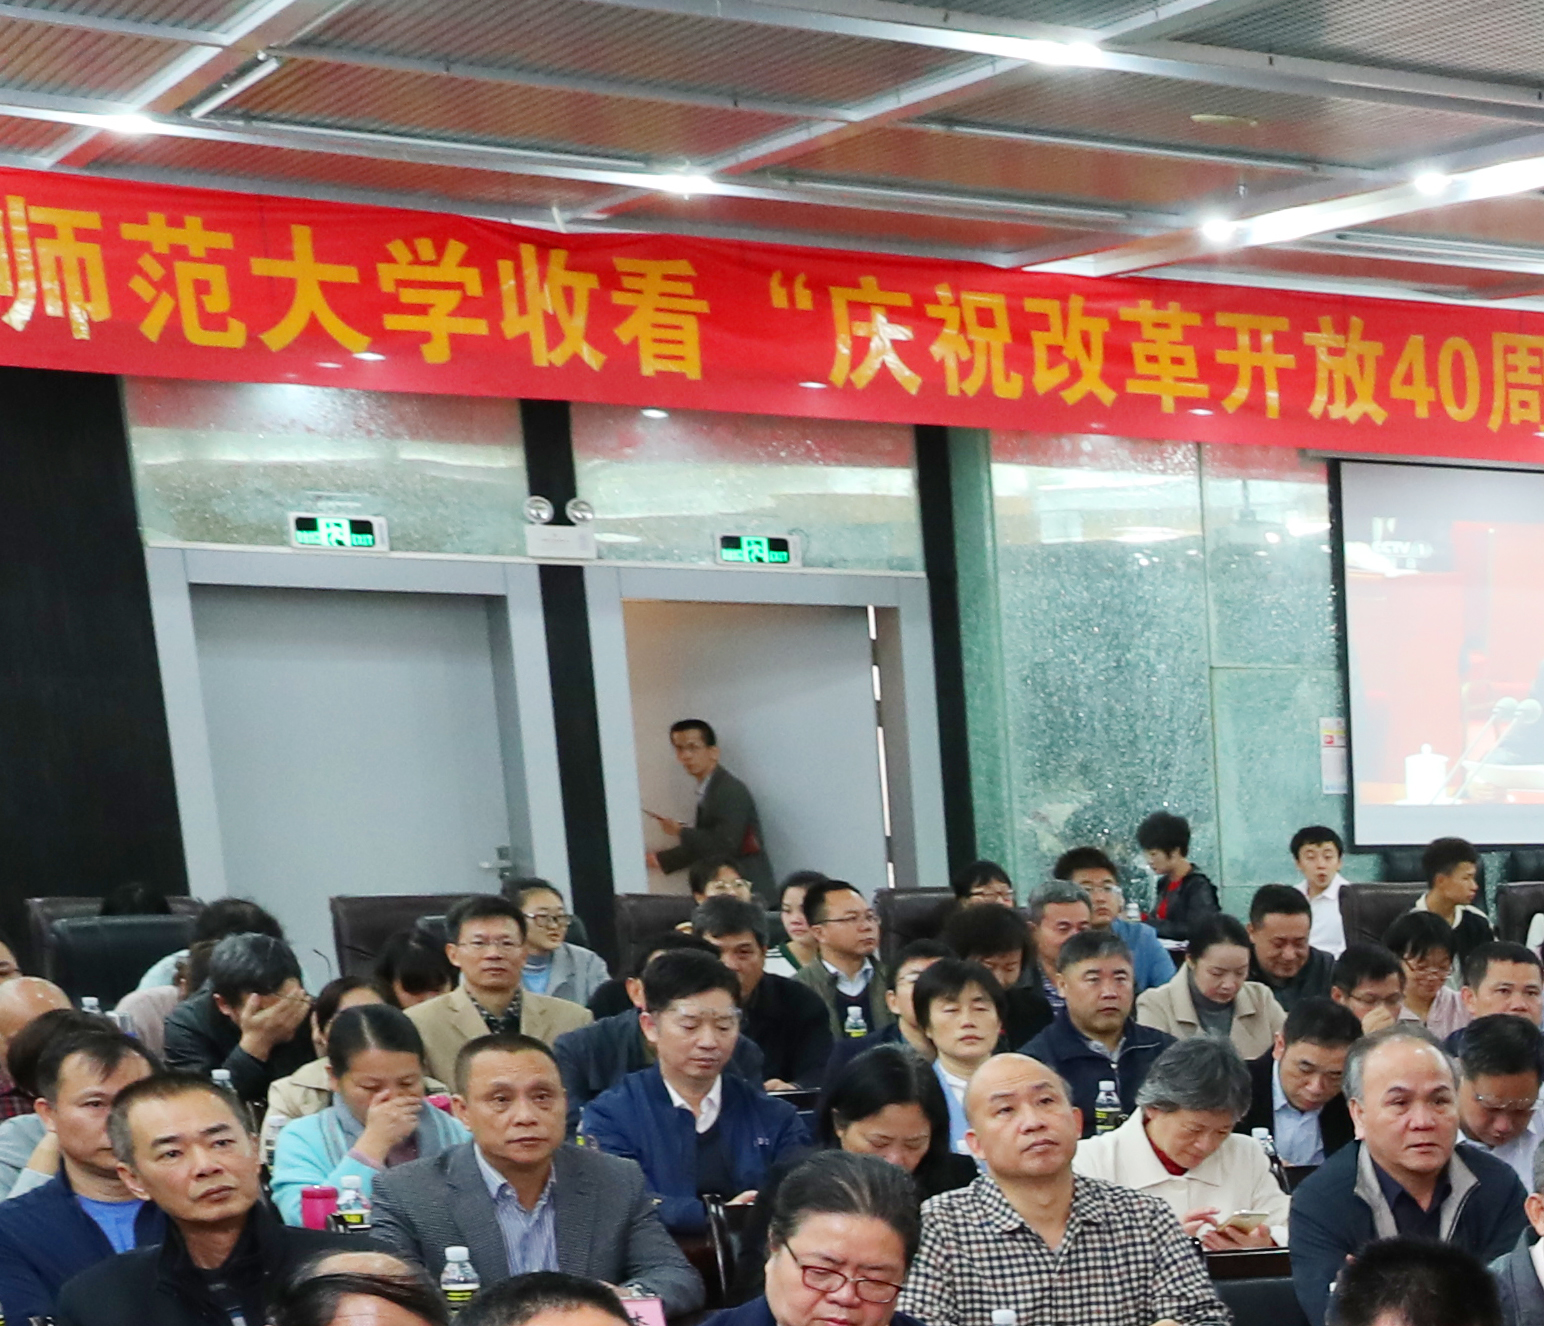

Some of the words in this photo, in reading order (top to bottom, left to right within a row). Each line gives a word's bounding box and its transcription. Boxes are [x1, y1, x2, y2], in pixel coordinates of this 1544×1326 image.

[0, 195, 711, 381] 师范大学收看
